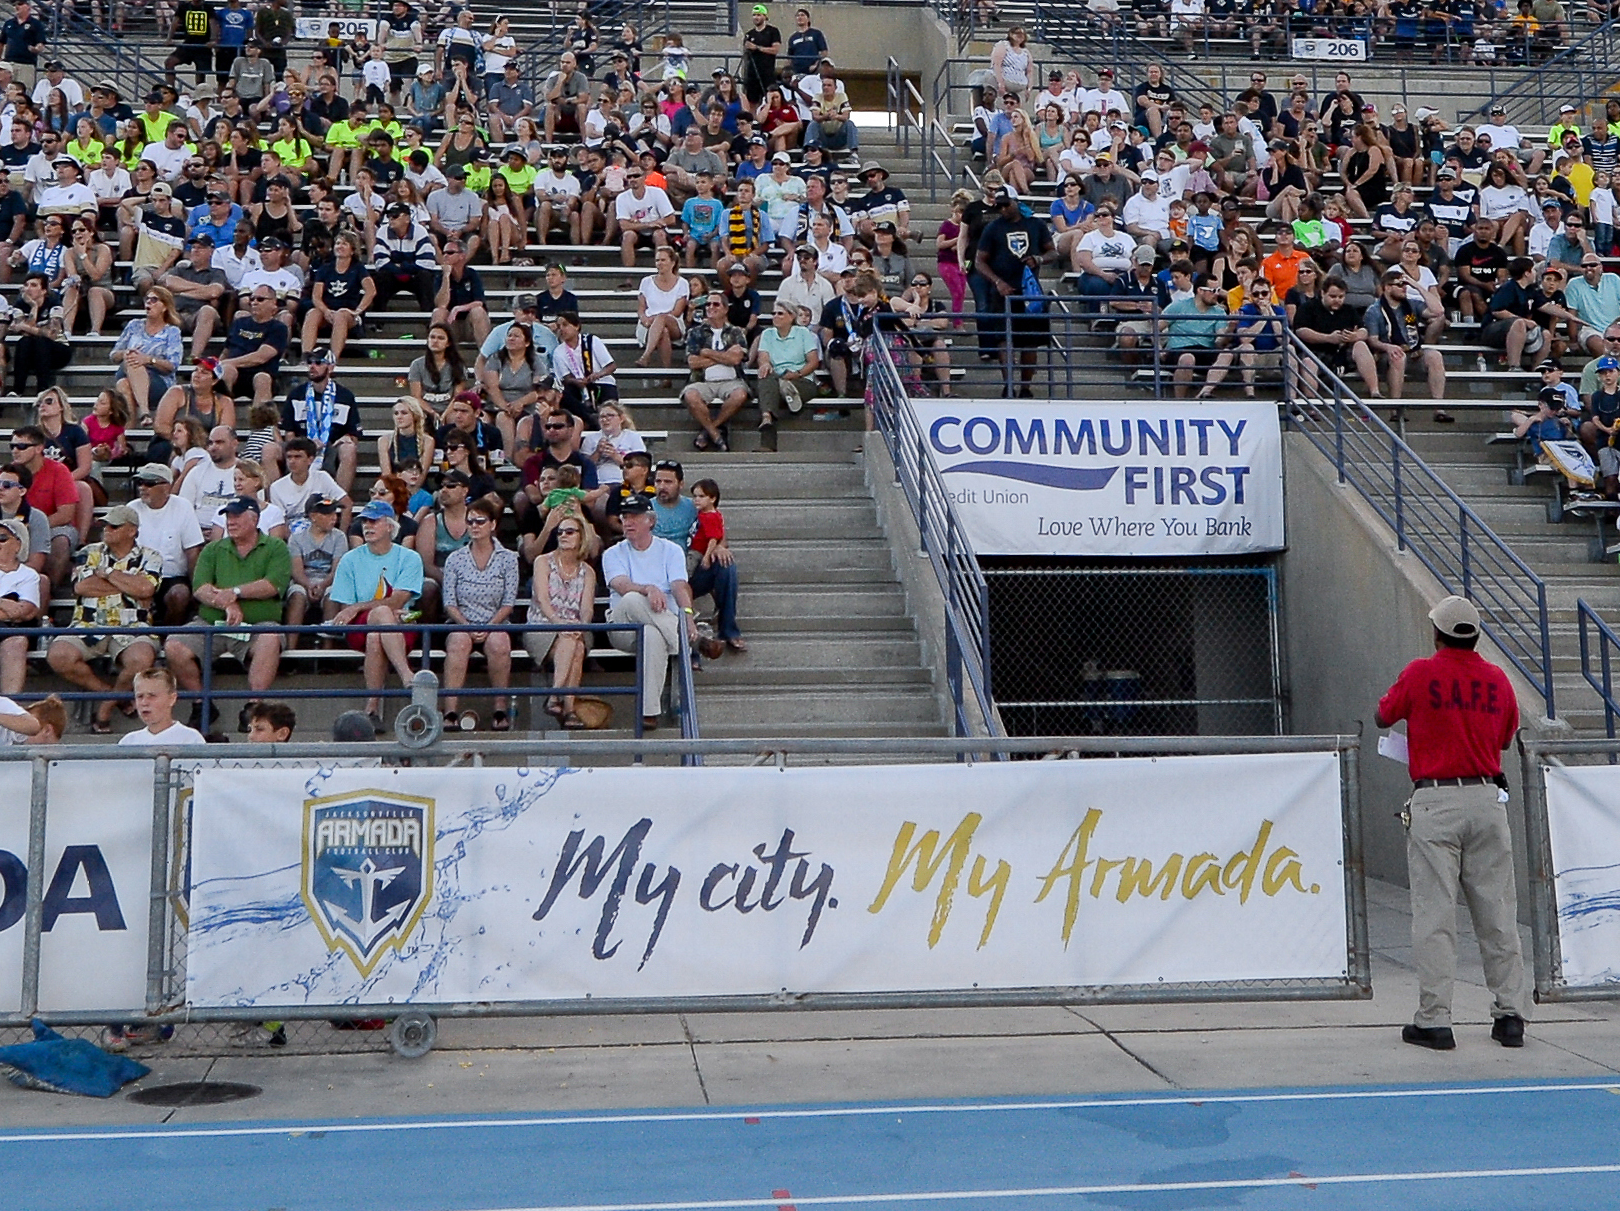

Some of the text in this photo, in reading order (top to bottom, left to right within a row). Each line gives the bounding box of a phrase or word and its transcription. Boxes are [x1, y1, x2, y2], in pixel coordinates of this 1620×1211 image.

[1327, 42, 1359, 57] 206
[929, 415, 1249, 458] COMMUNITY
[983, 489, 1030, 505] Union
[1124, 465, 1252, 507] FIRST
[1038, 516, 1253, 538] Love Where You Bank
[325, 809, 414, 819] JACKSONVILLE
[315, 817, 422, 860] ARMADA
[325, 846, 411, 856] FOOTBALL CLUB
[532, 808, 1321, 973] My city. My Armada.
